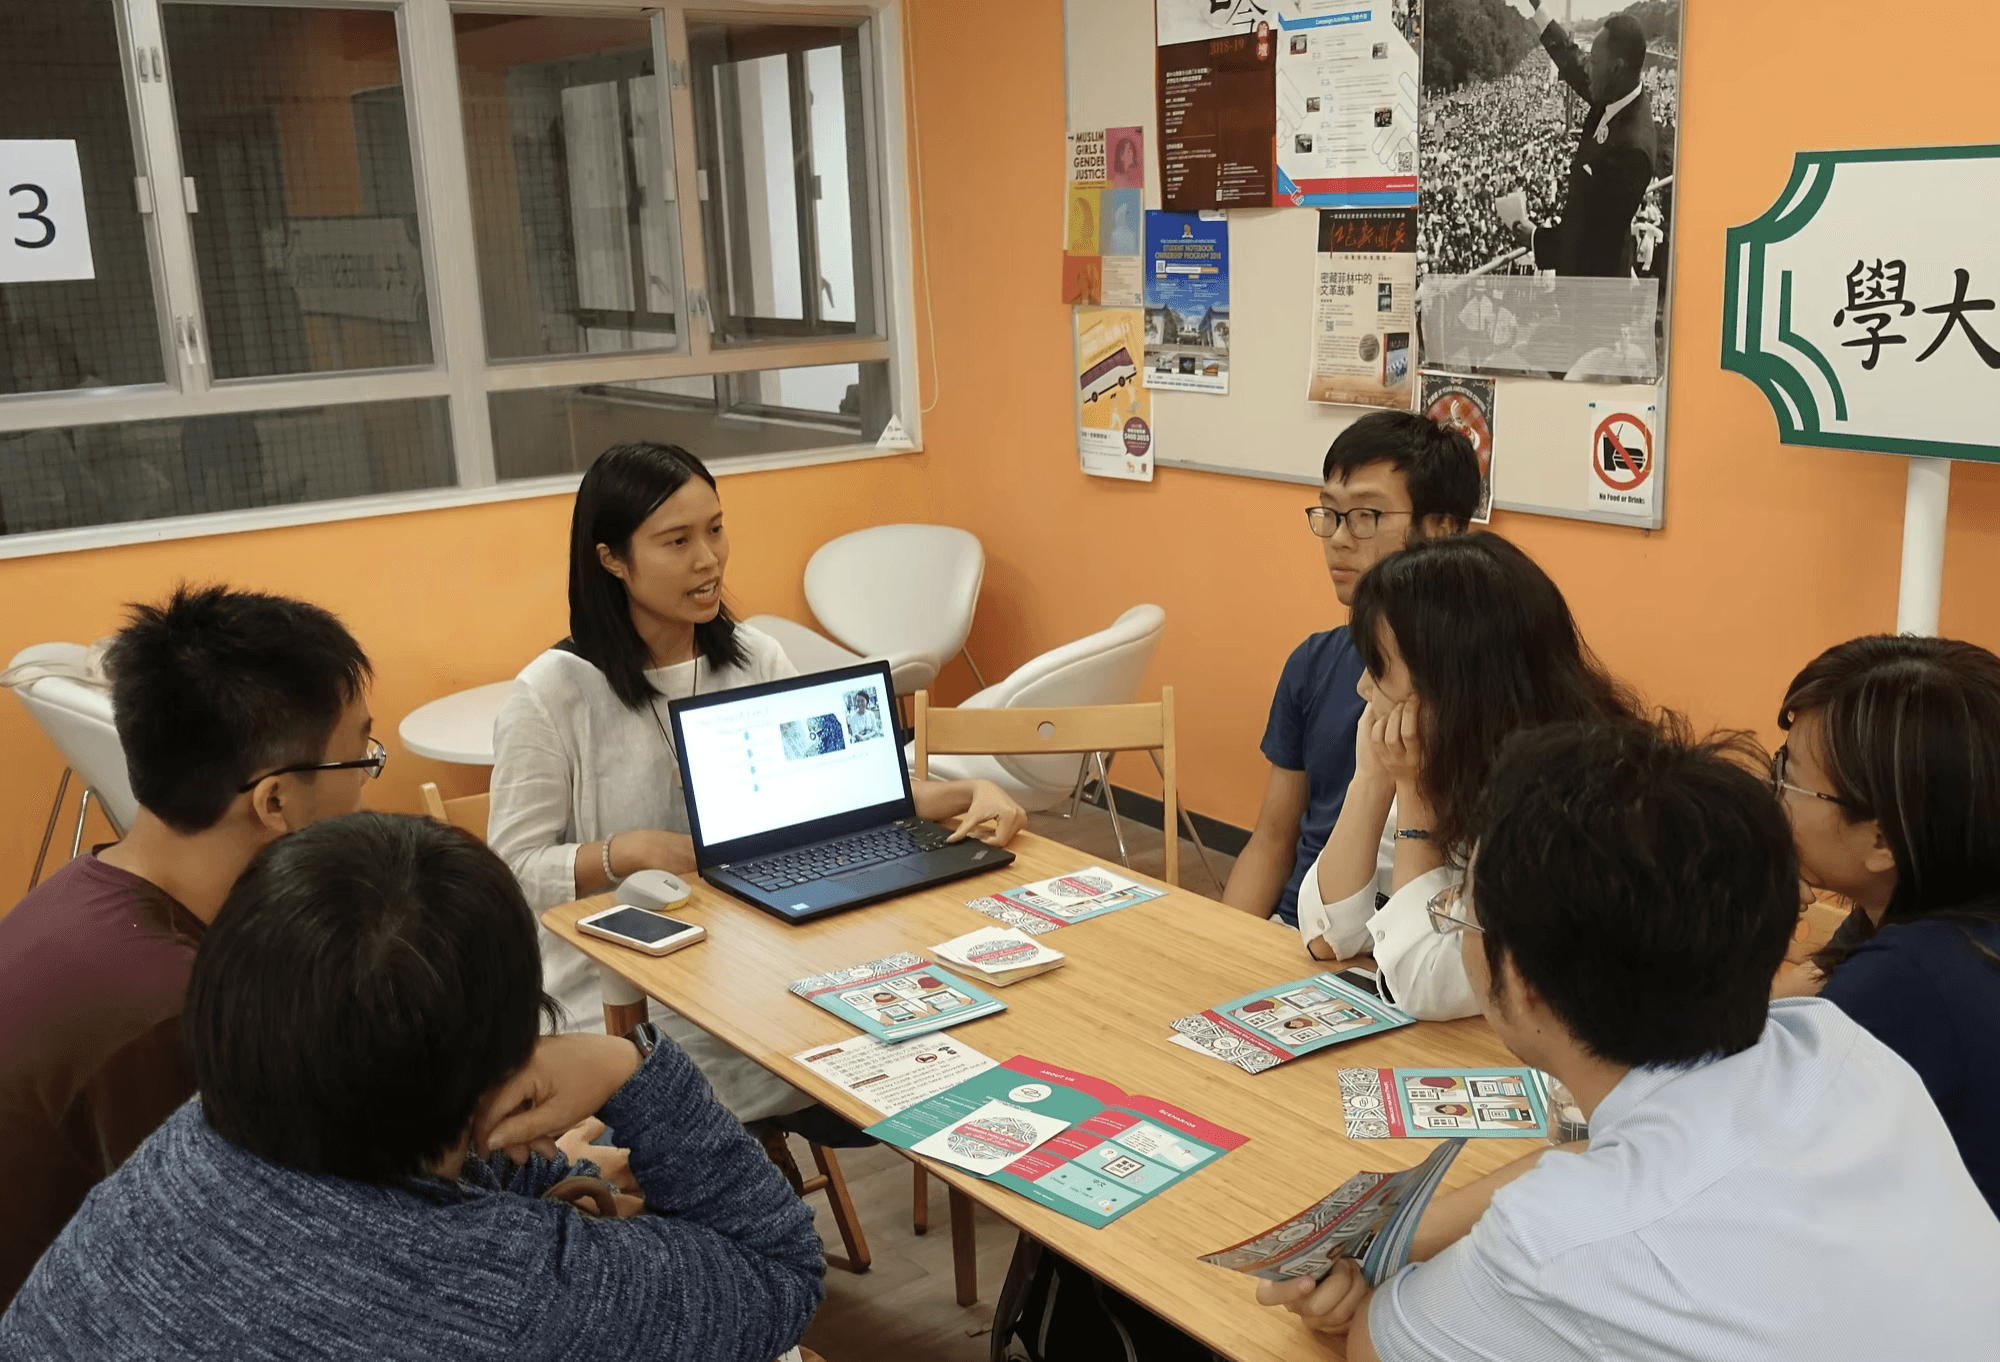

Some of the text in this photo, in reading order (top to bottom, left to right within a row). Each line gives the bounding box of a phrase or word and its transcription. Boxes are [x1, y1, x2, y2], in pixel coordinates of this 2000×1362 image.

[1076, 131, 1104, 143] MUSLIM
[1075, 144, 1104, 155] GIRLS &
[1073, 156, 1105, 168] GENDER
[1075, 168, 1105, 180] JUSTICE
[8, 183, 57, 249] 3
[1163, 244, 1214, 252] STUDENT NOTEBOOK
[1320, 272, 1372, 284] 密藏菲林中的
[1320, 285, 1354, 296] 文革故事
[1628, 496, 1645, 504] Drinks
[878, 1072, 909, 1084] communal
[1040, 1069, 1064, 1079] ABOUT
[877, 1081, 911, 1096] commercial
[913, 1073, 934, 1083] activity
[1158, 1108, 1196, 1128] SCENARIOS
[1005, 1137, 1026, 1148] POWER
